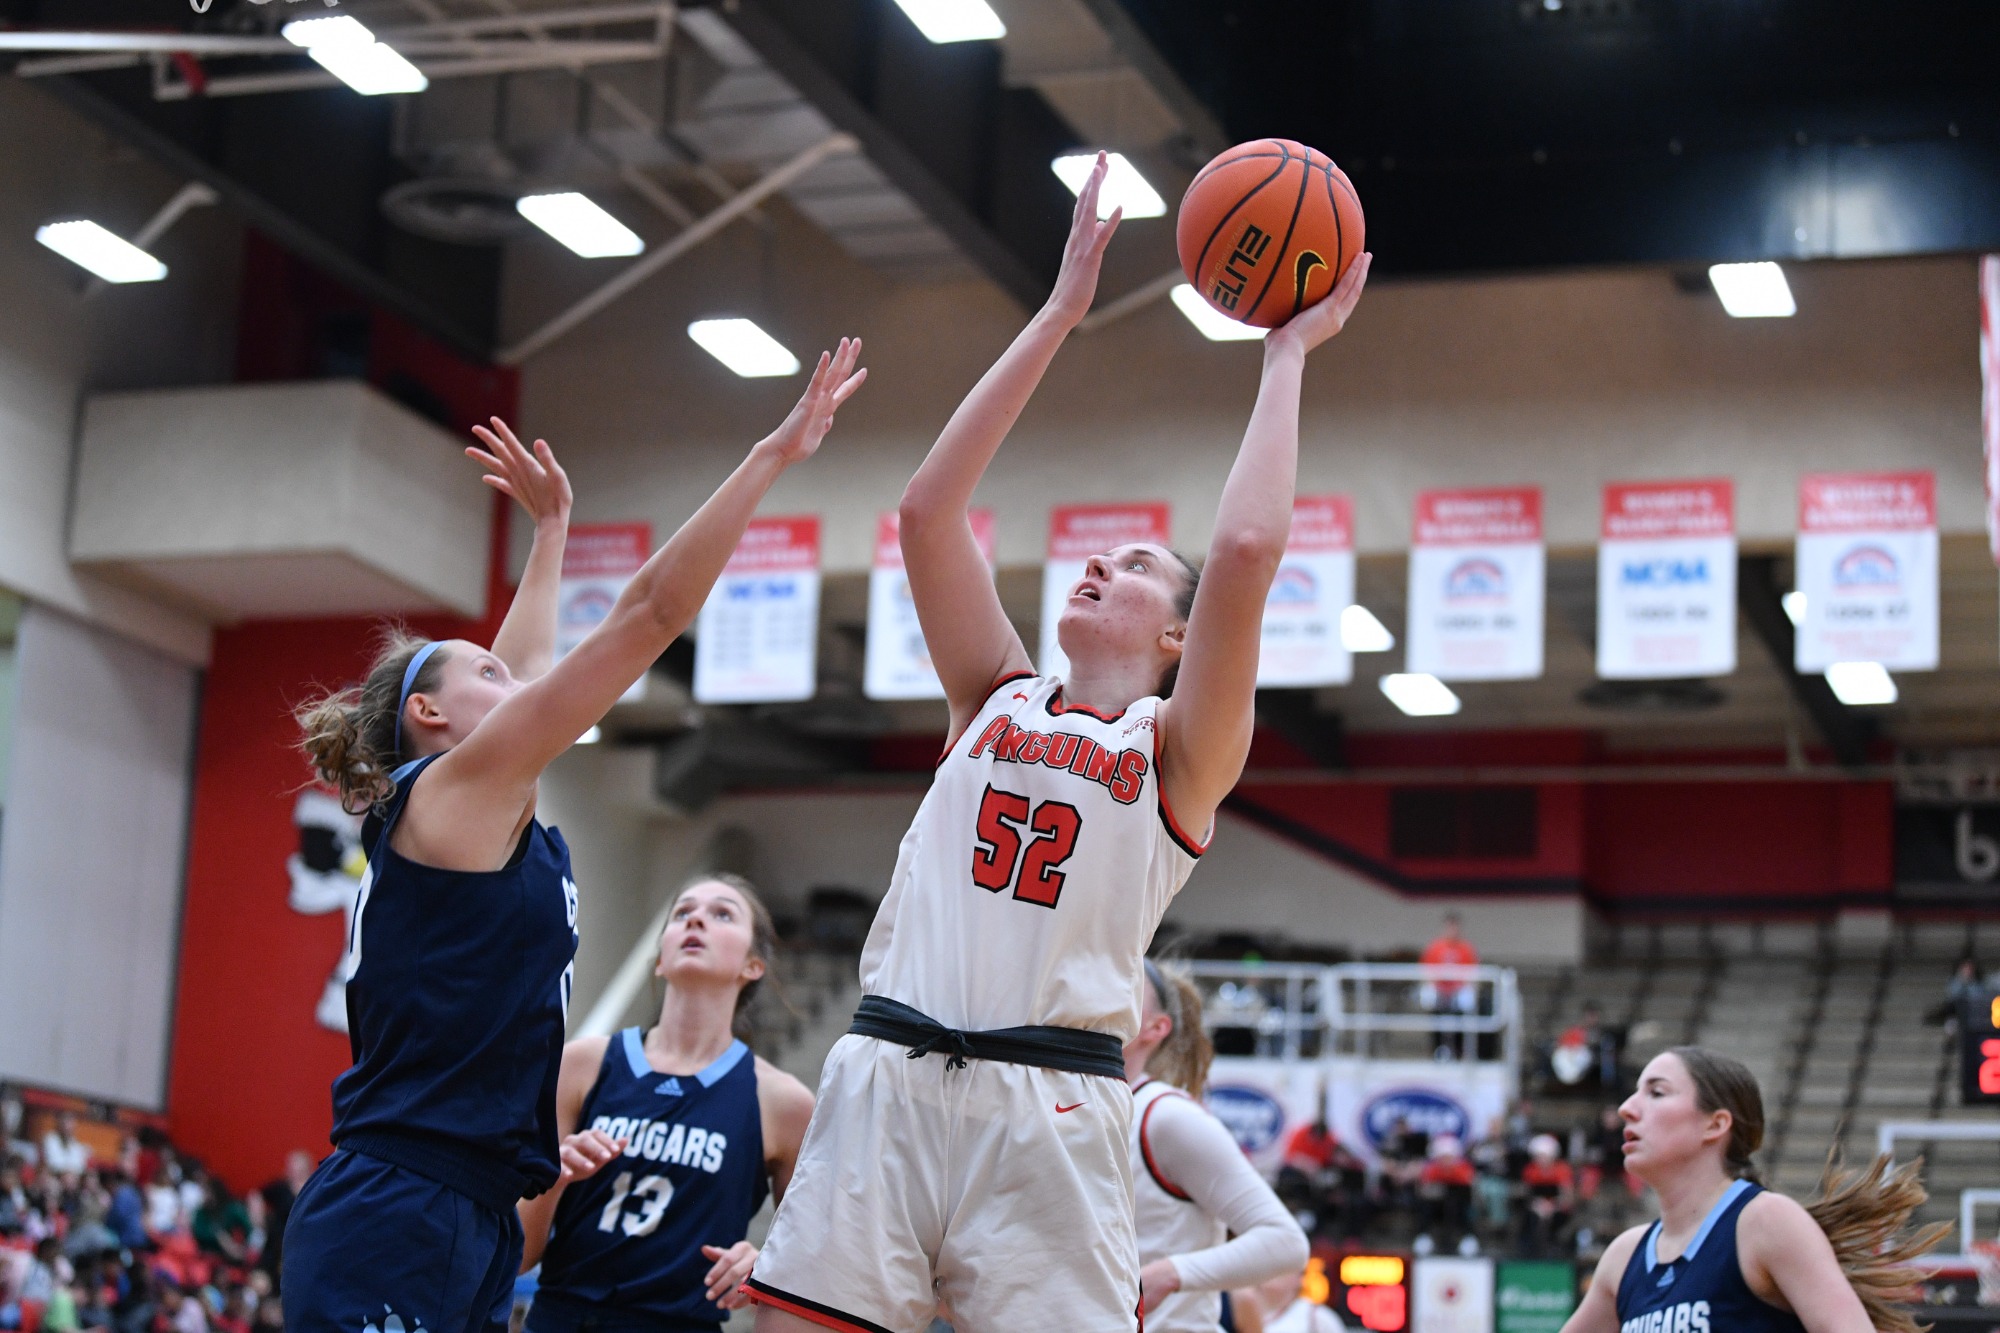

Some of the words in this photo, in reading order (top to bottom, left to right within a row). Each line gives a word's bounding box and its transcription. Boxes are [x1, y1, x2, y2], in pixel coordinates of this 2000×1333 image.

[1212, 223, 1272, 312] ELITE
[968, 714, 1148, 805] PNGUINS
[972, 782, 1083, 909] 52
[597, 1171, 675, 1238] 13
